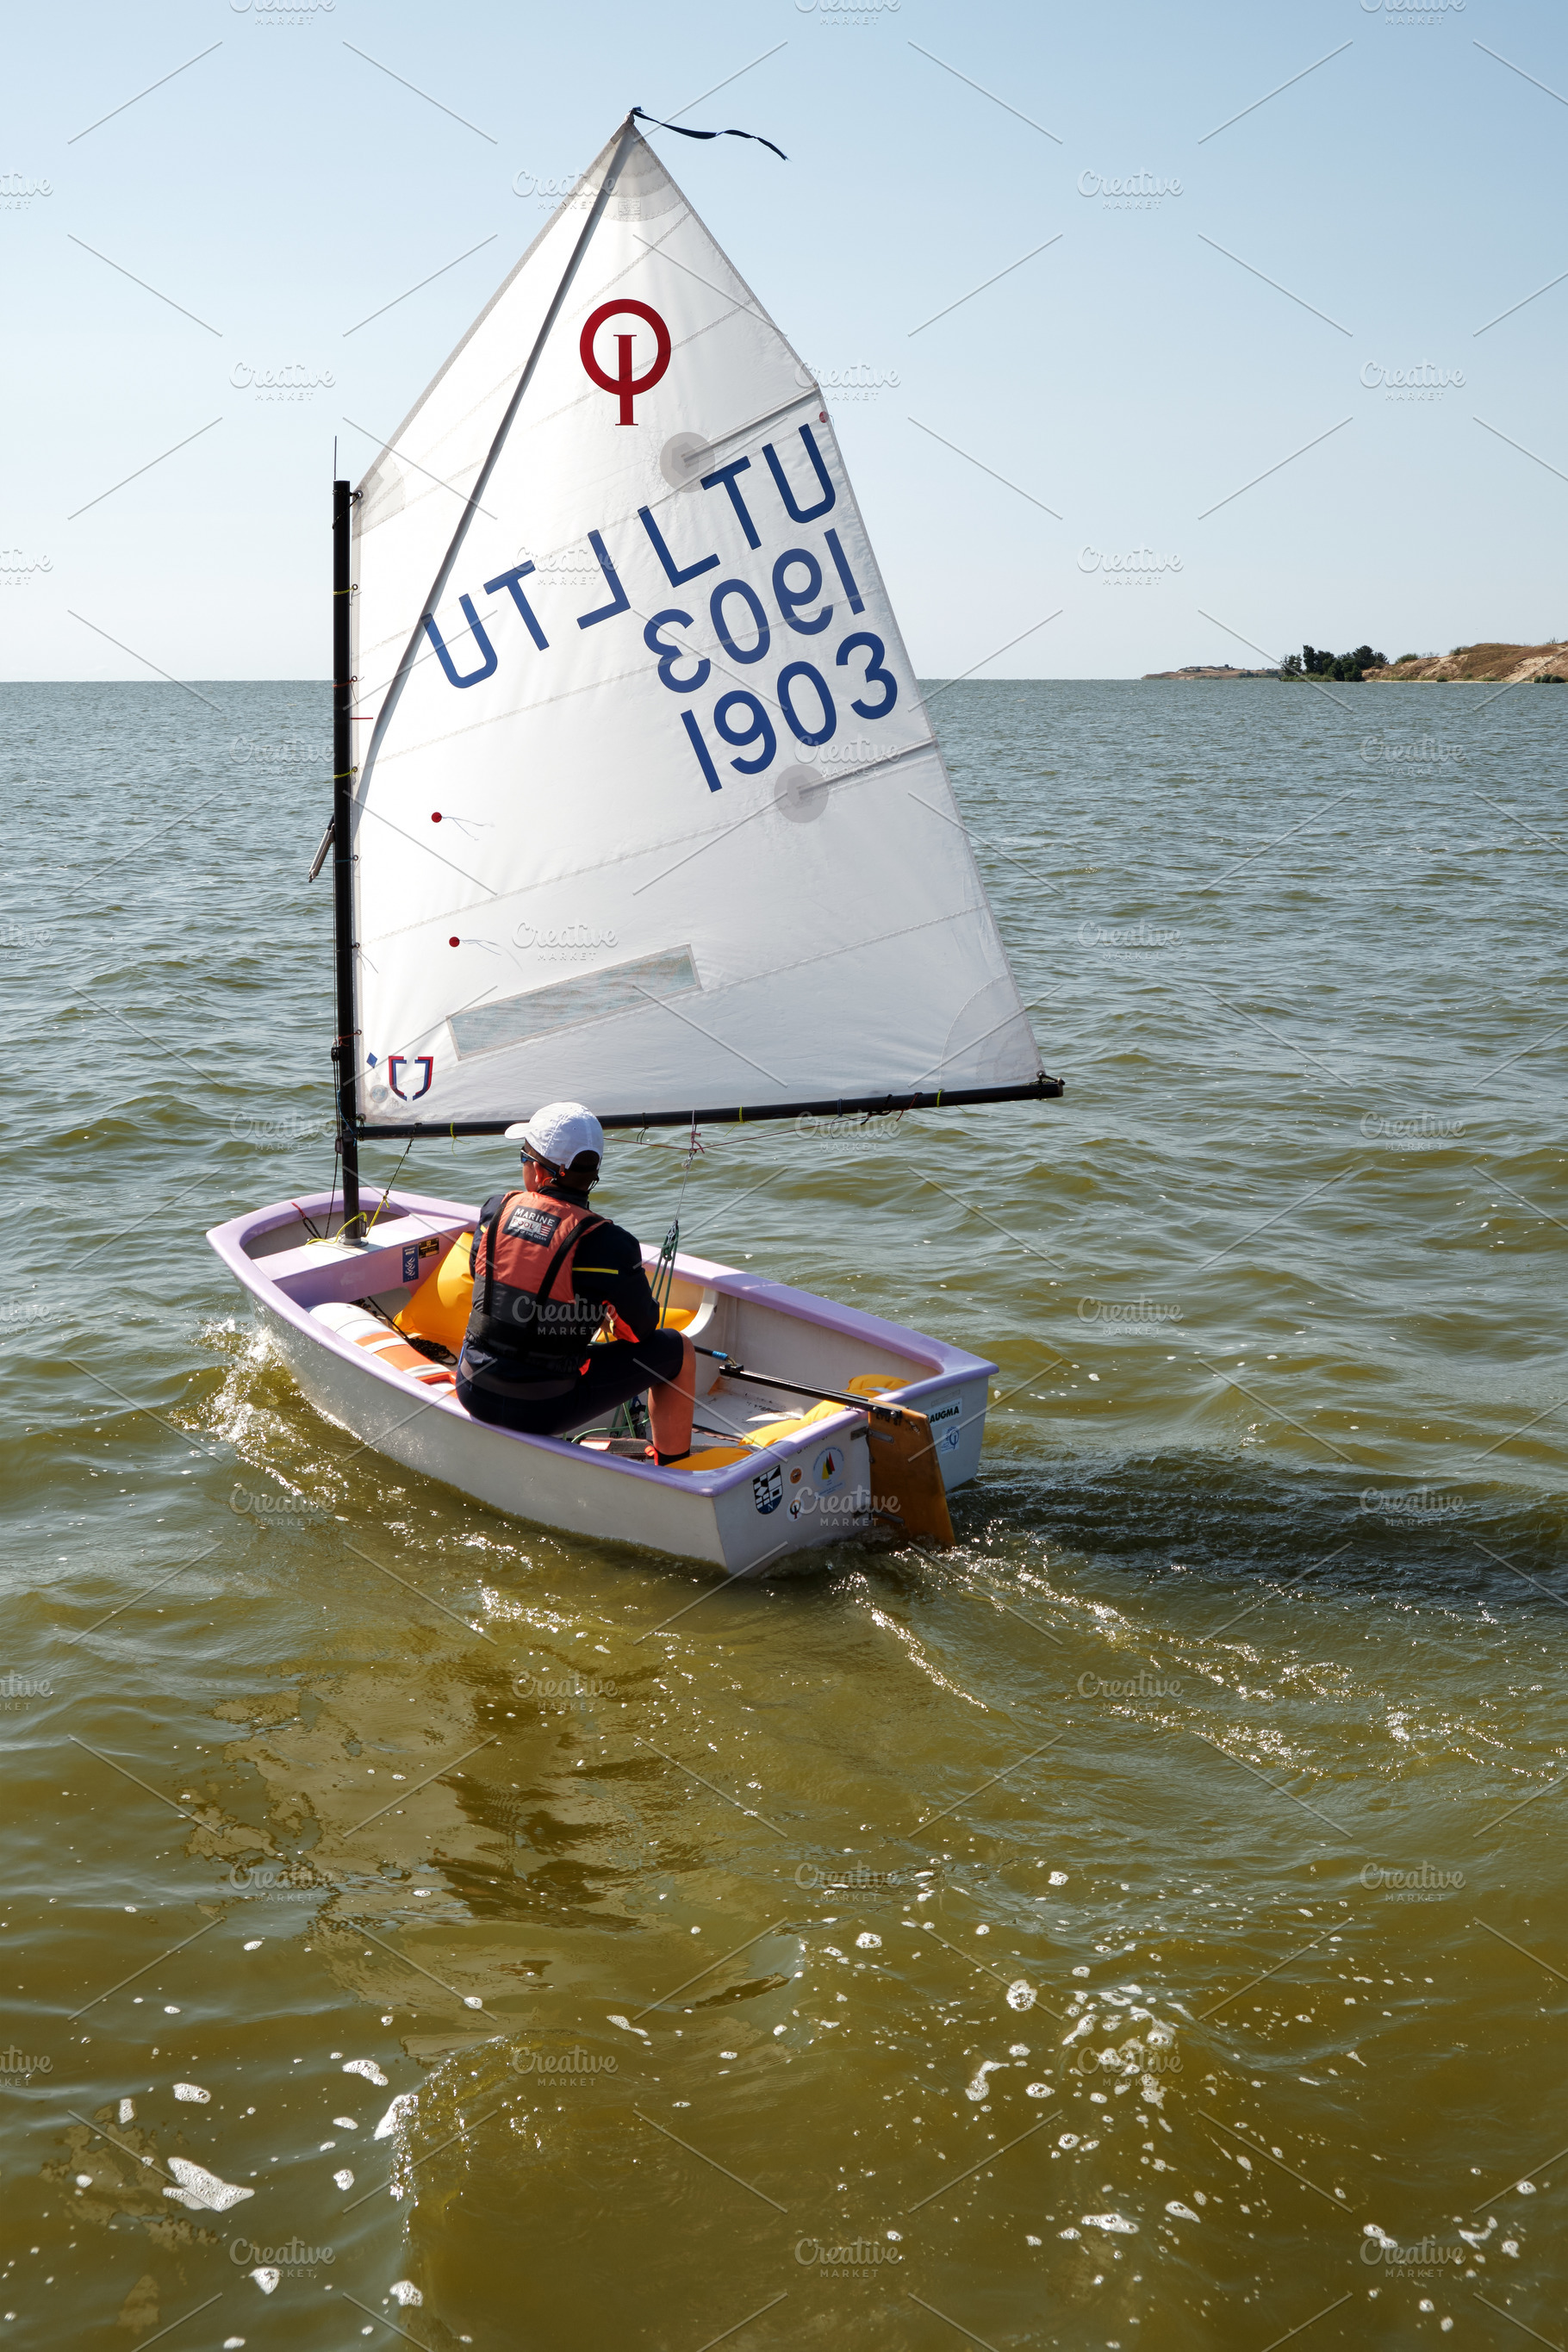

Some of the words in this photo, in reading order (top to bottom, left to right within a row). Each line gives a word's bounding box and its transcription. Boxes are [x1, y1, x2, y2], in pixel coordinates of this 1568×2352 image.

[681, 632, 899, 793] 1903
[512, 1218, 534, 1230] POOL
[514, 1208, 555, 1227] MARINE
[928, 1406, 960, 1423] AUGMA
